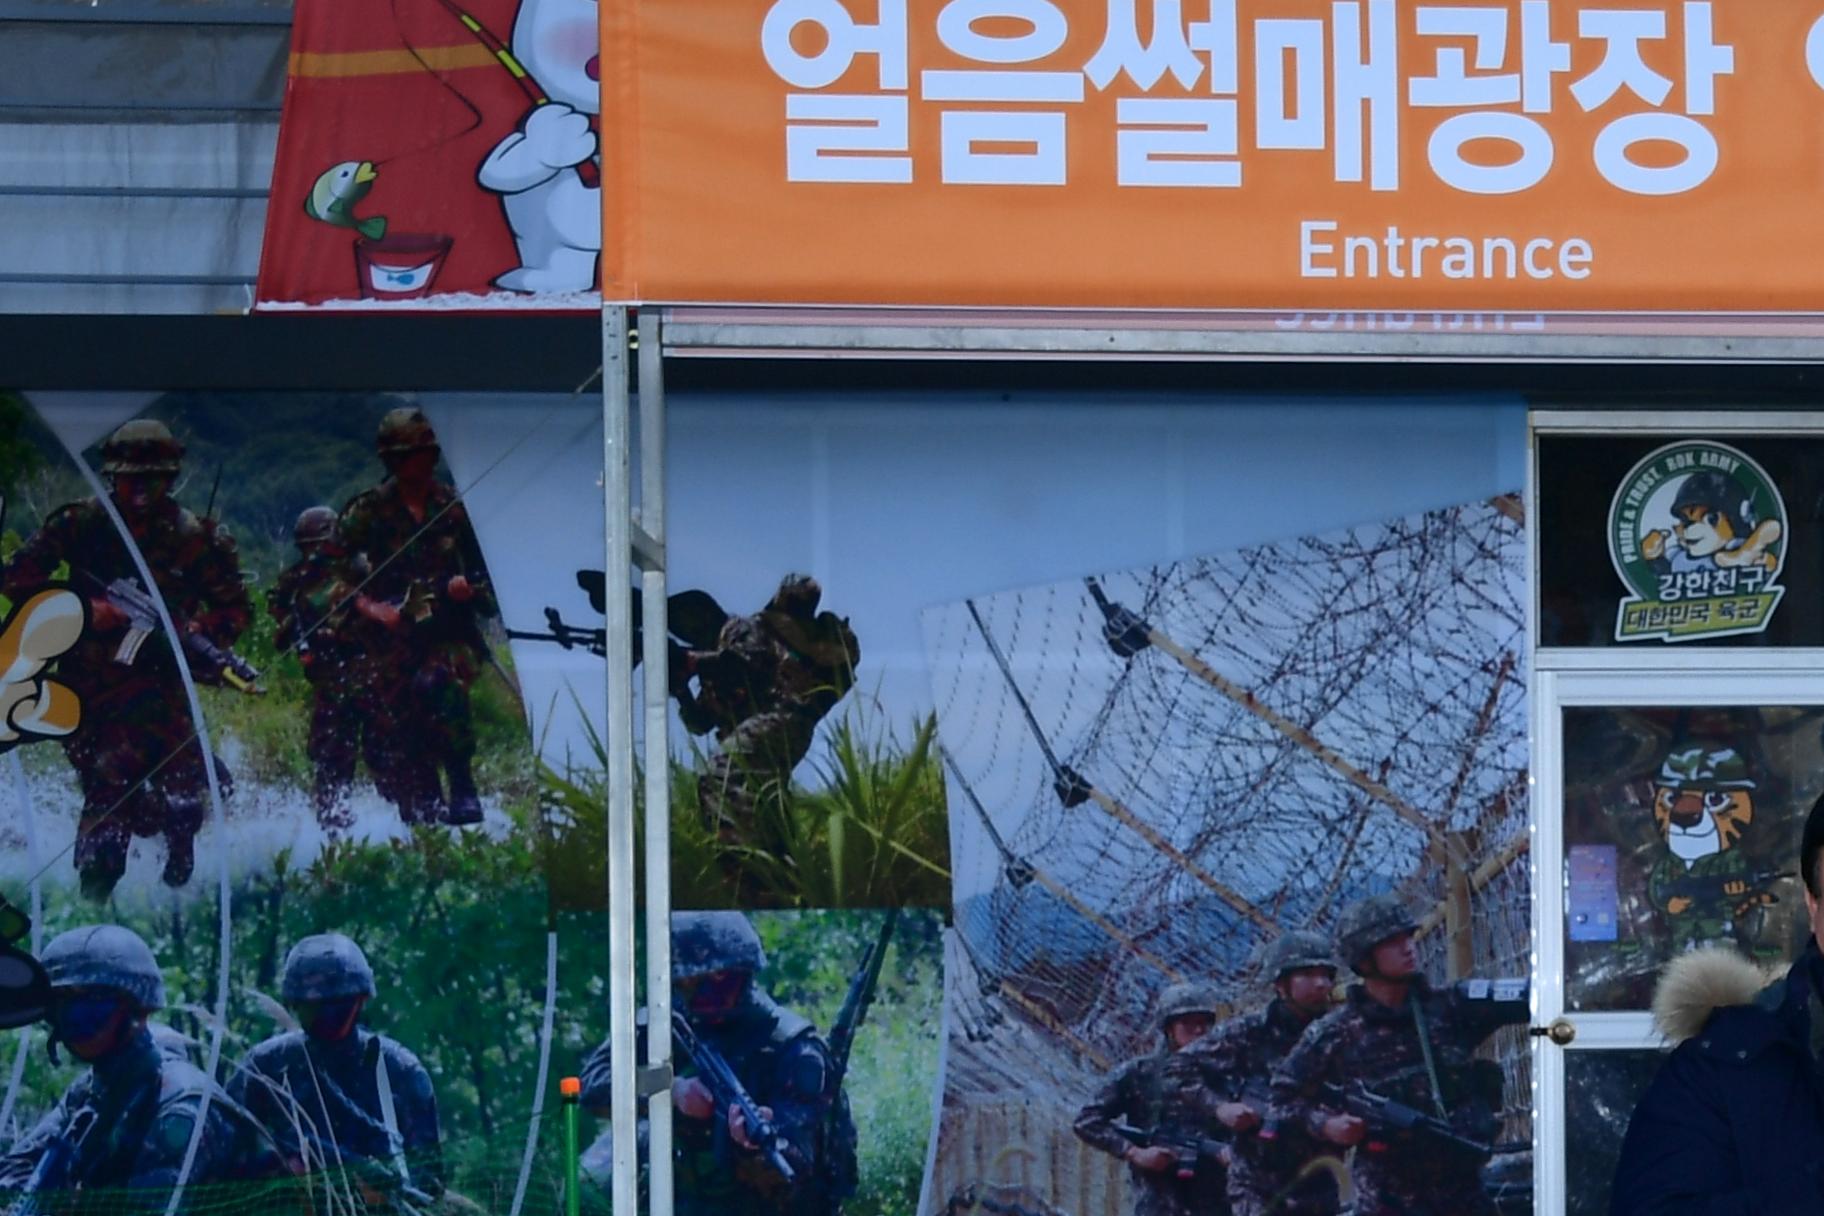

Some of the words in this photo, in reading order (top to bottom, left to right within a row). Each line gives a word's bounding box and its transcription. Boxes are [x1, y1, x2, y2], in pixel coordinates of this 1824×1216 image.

[761, 0, 1734, 195] 얼음썰매광장
[1301, 221, 1593, 279] Entrance
[1618, 520, 1640, 564] PRIDE
[1665, 452, 1696, 472] ROK
[1699, 451, 1741, 475] ARMY
[1658, 566, 1764, 601] 강한친구
[1626, 602, 1711, 630] 대한민국
[1717, 598, 1761, 622] 육군
